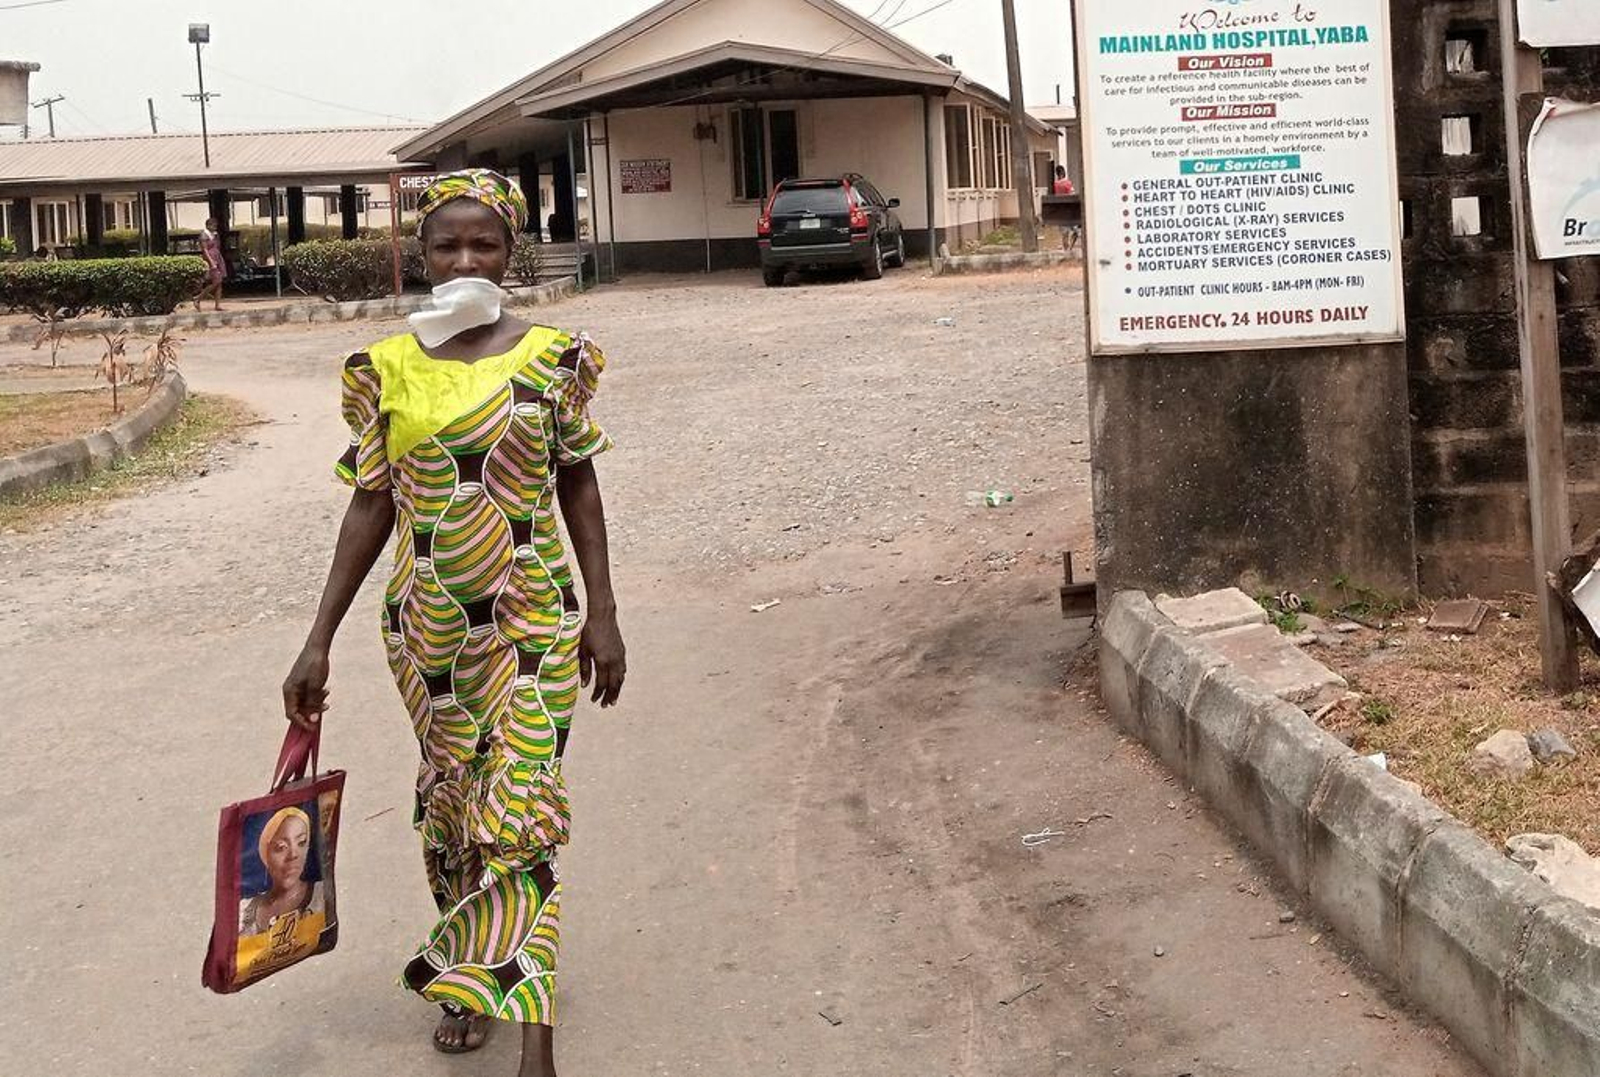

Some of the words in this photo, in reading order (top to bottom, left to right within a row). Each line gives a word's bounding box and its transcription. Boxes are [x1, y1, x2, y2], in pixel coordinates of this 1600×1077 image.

[1180, 9, 1279, 33] Welcome
[1292, 3, 1316, 22] to
[1100, 33, 1207, 54] MAINLAND
[1188, 58, 1216, 70] Our
[1219, 55, 1265, 69] Vision
[1100, 75, 1112, 84] To
[1114, 74, 1147, 84] create
[1158, 71, 1207, 82] reference
[1209, 68, 1241, 80] health
[1243, 67, 1277, 78] facility
[1280, 66, 1311, 76] where
[1313, 65, 1330, 74] the
[1336, 63, 1356, 73] best
[1360, 62, 1370, 72] of
[1104, 88, 1127, 96] care
[1129, 86, 1143, 95] for
[1146, 84, 1195, 94] infectious
[1198, 82, 1216, 92] and
[1218, 79, 1289, 91] communicable
[1291, 77, 1332, 88] diseases
[1335, 77, 1352, 86] can
[1354, 75, 1367, 85] be
[1169, 95, 1213, 106] provided
[1216, 95, 1226, 104] in
[1229, 93, 1245, 103] the
[1186, 107, 1213, 119] Our
[1216, 104, 1272, 117] Mission
[1106, 127, 1118, 136] To
[1120, 125, 1157, 137] provide
[1203, 122, 1247, 132] effective
[1250, 120, 1268, 130] and
[1271, 118, 1312, 129] efficient
[1315, 117, 1370, 128] world-class
[1111, 140, 1151, 149] services
[1154, 138, 1165, 147] to
[1167, 138, 1184, 147] our
[1186, 135, 1219, 146] clients
[1222, 135, 1233, 144] in
[1235, 136, 1241, 144] a
[1243, 133, 1280, 145] homely
[1282, 130, 1345, 141] environment
[1348, 129, 1360, 141] by
[1362, 131, 1369, 139] a
[1151, 150, 1177, 159] team
[1180, 148, 1190, 158] of
[1193, 161, 1221, 174] Our
[1224, 158, 1288, 172] Services
[1133, 179, 1192, 192] GENERAL
[1196, 174, 1277, 189] OUT-PATIENT
[1281, 172, 1323, 184] CLINIC
[1134, 191, 1176, 203] HEART
[1180, 190, 1197, 201] TO
[1200, 187, 1242, 200] HEART
[1246, 183, 1310, 200] (HIV/AIDS)
[1313, 183, 1356, 195] CLINIC
[1134, 205, 1176, 218] CHEST
[1187, 203, 1220, 215] DOTS
[1224, 201, 1267, 213] CLINIC
[1136, 216, 1230, 230] RADIOLOGICAL
[1233, 212, 1280, 228] (X-RAY)
[1283, 211, 1345, 225] SERVICES
[1137, 230, 1221, 245] LABORATORY
[1225, 227, 1287, 241] SERVICES
[1294, 237, 1356, 251] SERVICES
[1138, 258, 1208, 272] MORTUARY
[1211, 255, 1274, 269] SERVICES
[1277, 251, 1343, 267] (CORONER
[1346, 249, 1392, 263] CASES)
[1137, 285, 1195, 298] OUT-PATIENT
[1200, 283, 1230, 295] CLINIC
[1232, 281, 1263, 294] HOURS
[1231, 311, 1250, 327] 24
[1256, 308, 1314, 326] HOURS
[1320, 305, 1369, 323] DAILY
